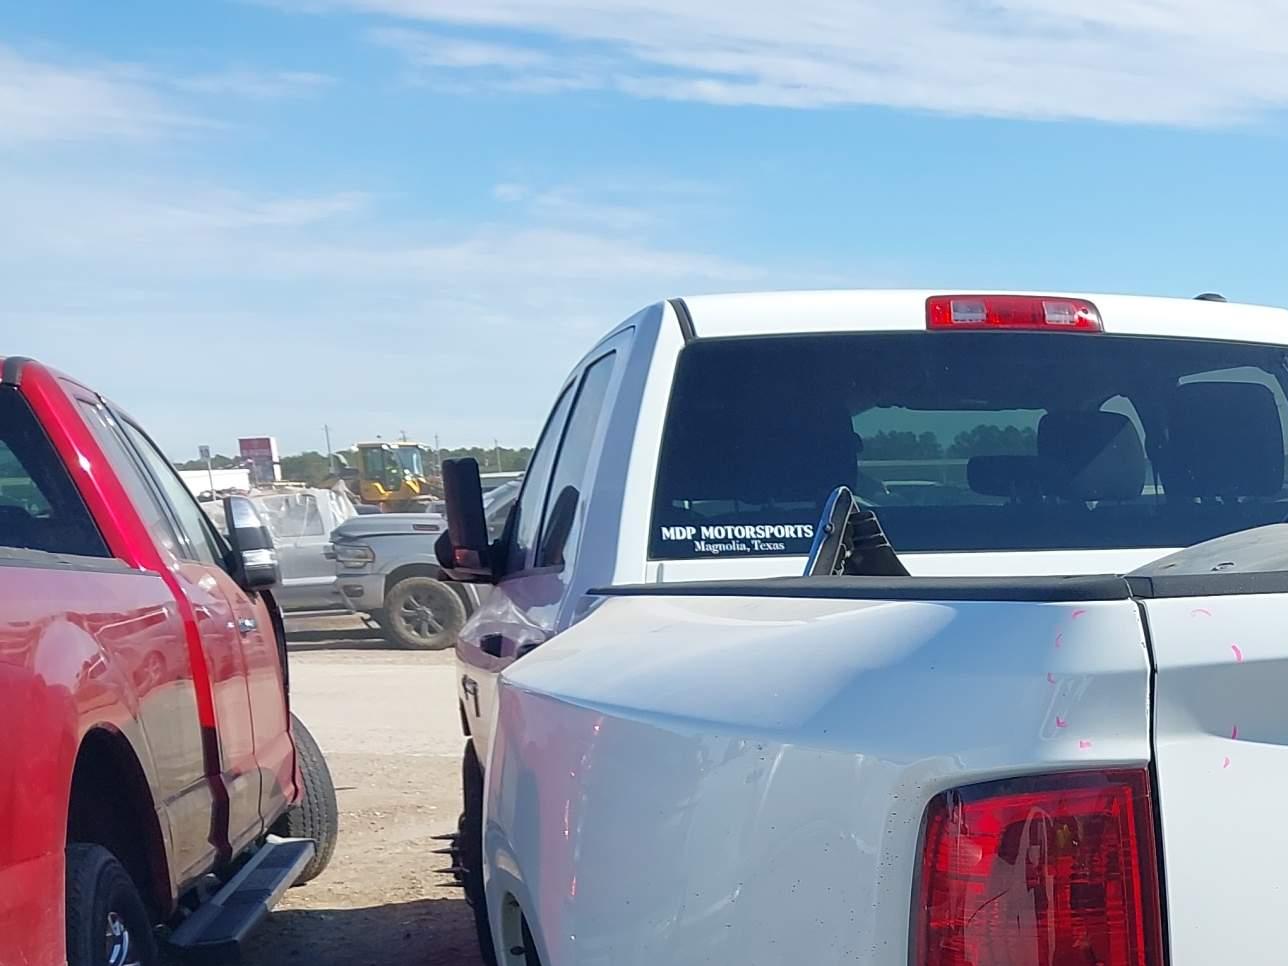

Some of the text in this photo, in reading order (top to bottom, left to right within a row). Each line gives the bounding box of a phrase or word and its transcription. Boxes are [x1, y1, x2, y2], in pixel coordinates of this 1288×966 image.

[661, 524, 814, 540] MDP MOTORSPORTS
[694, 540, 785, 554] Magnolia, Texas
